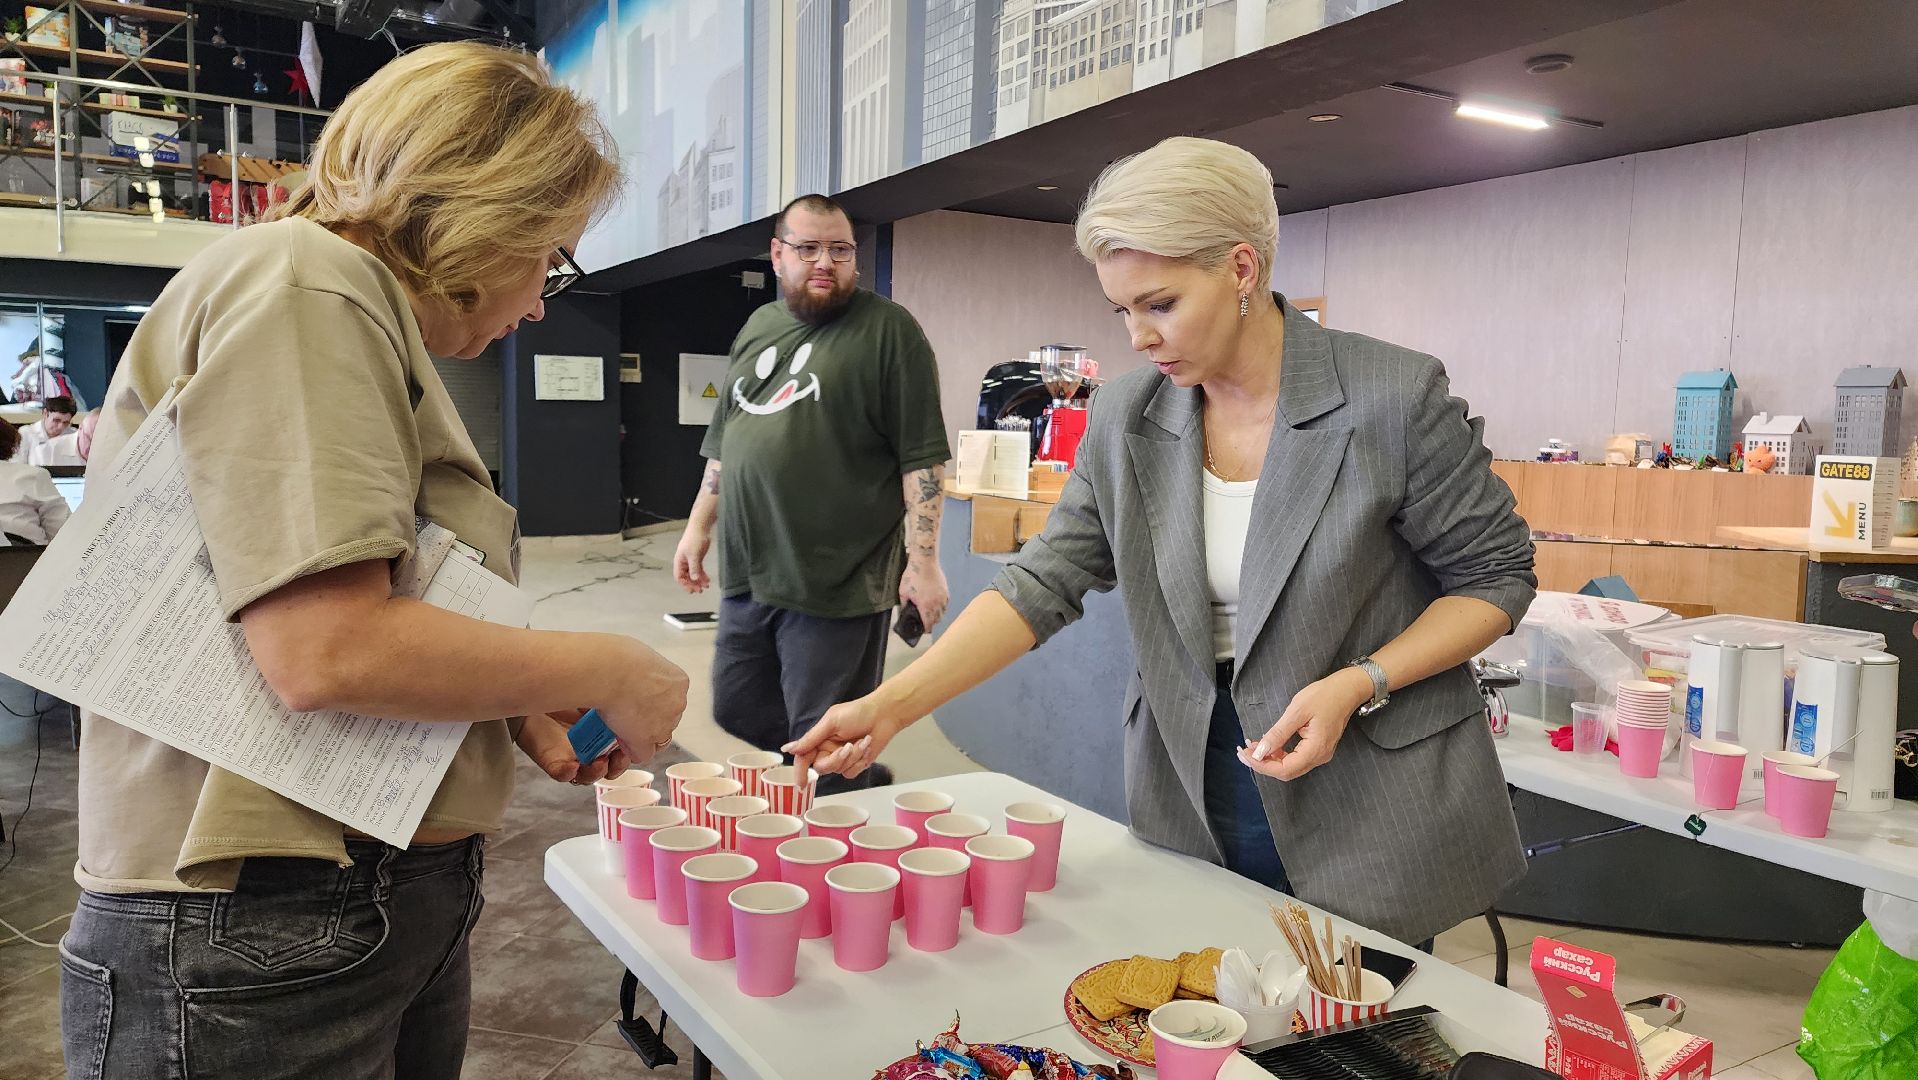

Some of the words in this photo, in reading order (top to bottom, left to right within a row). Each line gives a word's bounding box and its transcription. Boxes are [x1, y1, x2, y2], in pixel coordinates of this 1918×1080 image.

[1822, 463, 1870, 479] GATE88
[80, 531, 104, 561] АНКЕТА
[100, 503, 125, 533] ДОНОРА
[1858, 502, 1866, 540] MENU
[1544, 956, 1601, 983] Русский
[1553, 946, 1594, 967] сахар
[1558, 1017, 1628, 1050] Русский
[1565, 1013, 1614, 1037] сахар
